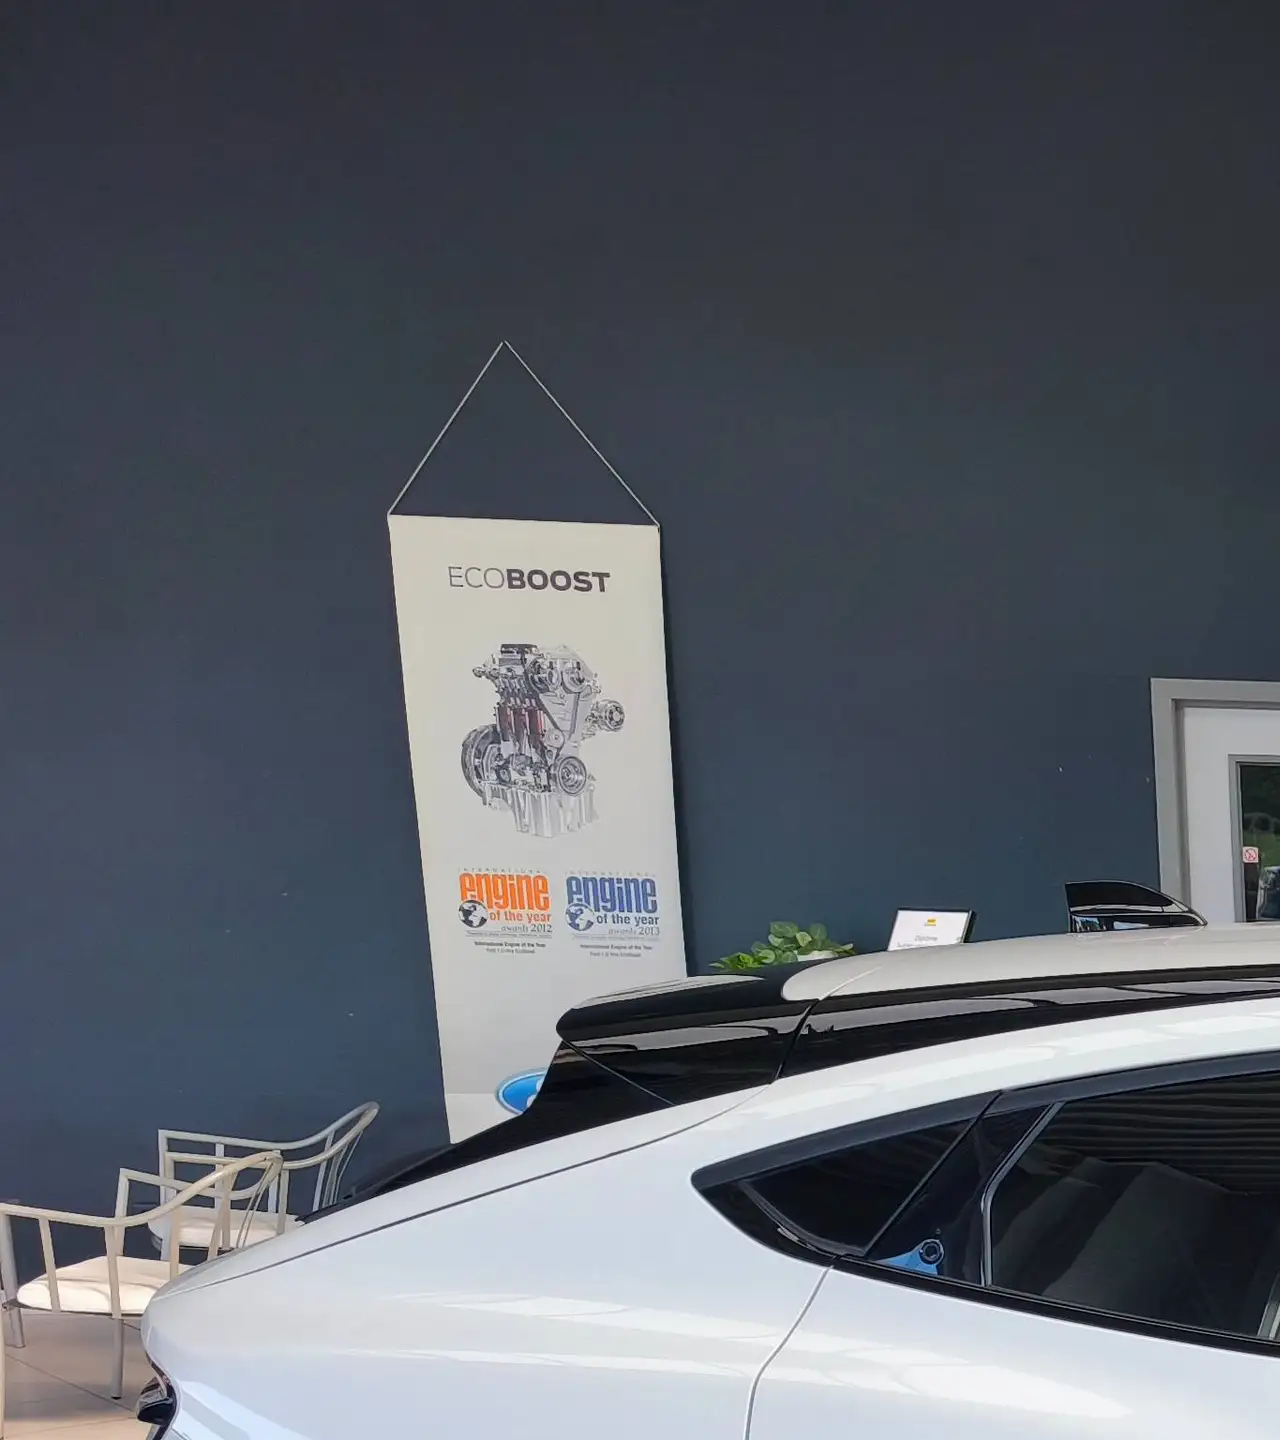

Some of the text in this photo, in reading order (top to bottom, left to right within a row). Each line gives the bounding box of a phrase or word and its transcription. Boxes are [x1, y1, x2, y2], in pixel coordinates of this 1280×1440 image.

[448, 566, 611, 592] ECOBOOST
[459, 873, 550, 911] engine
[566, 876, 657, 913] engine
[490, 911, 551, 924] of the year
[596, 913, 660, 927] of the year
[531, 924, 553, 933] 2012
[639, 927, 660, 936] 2013
